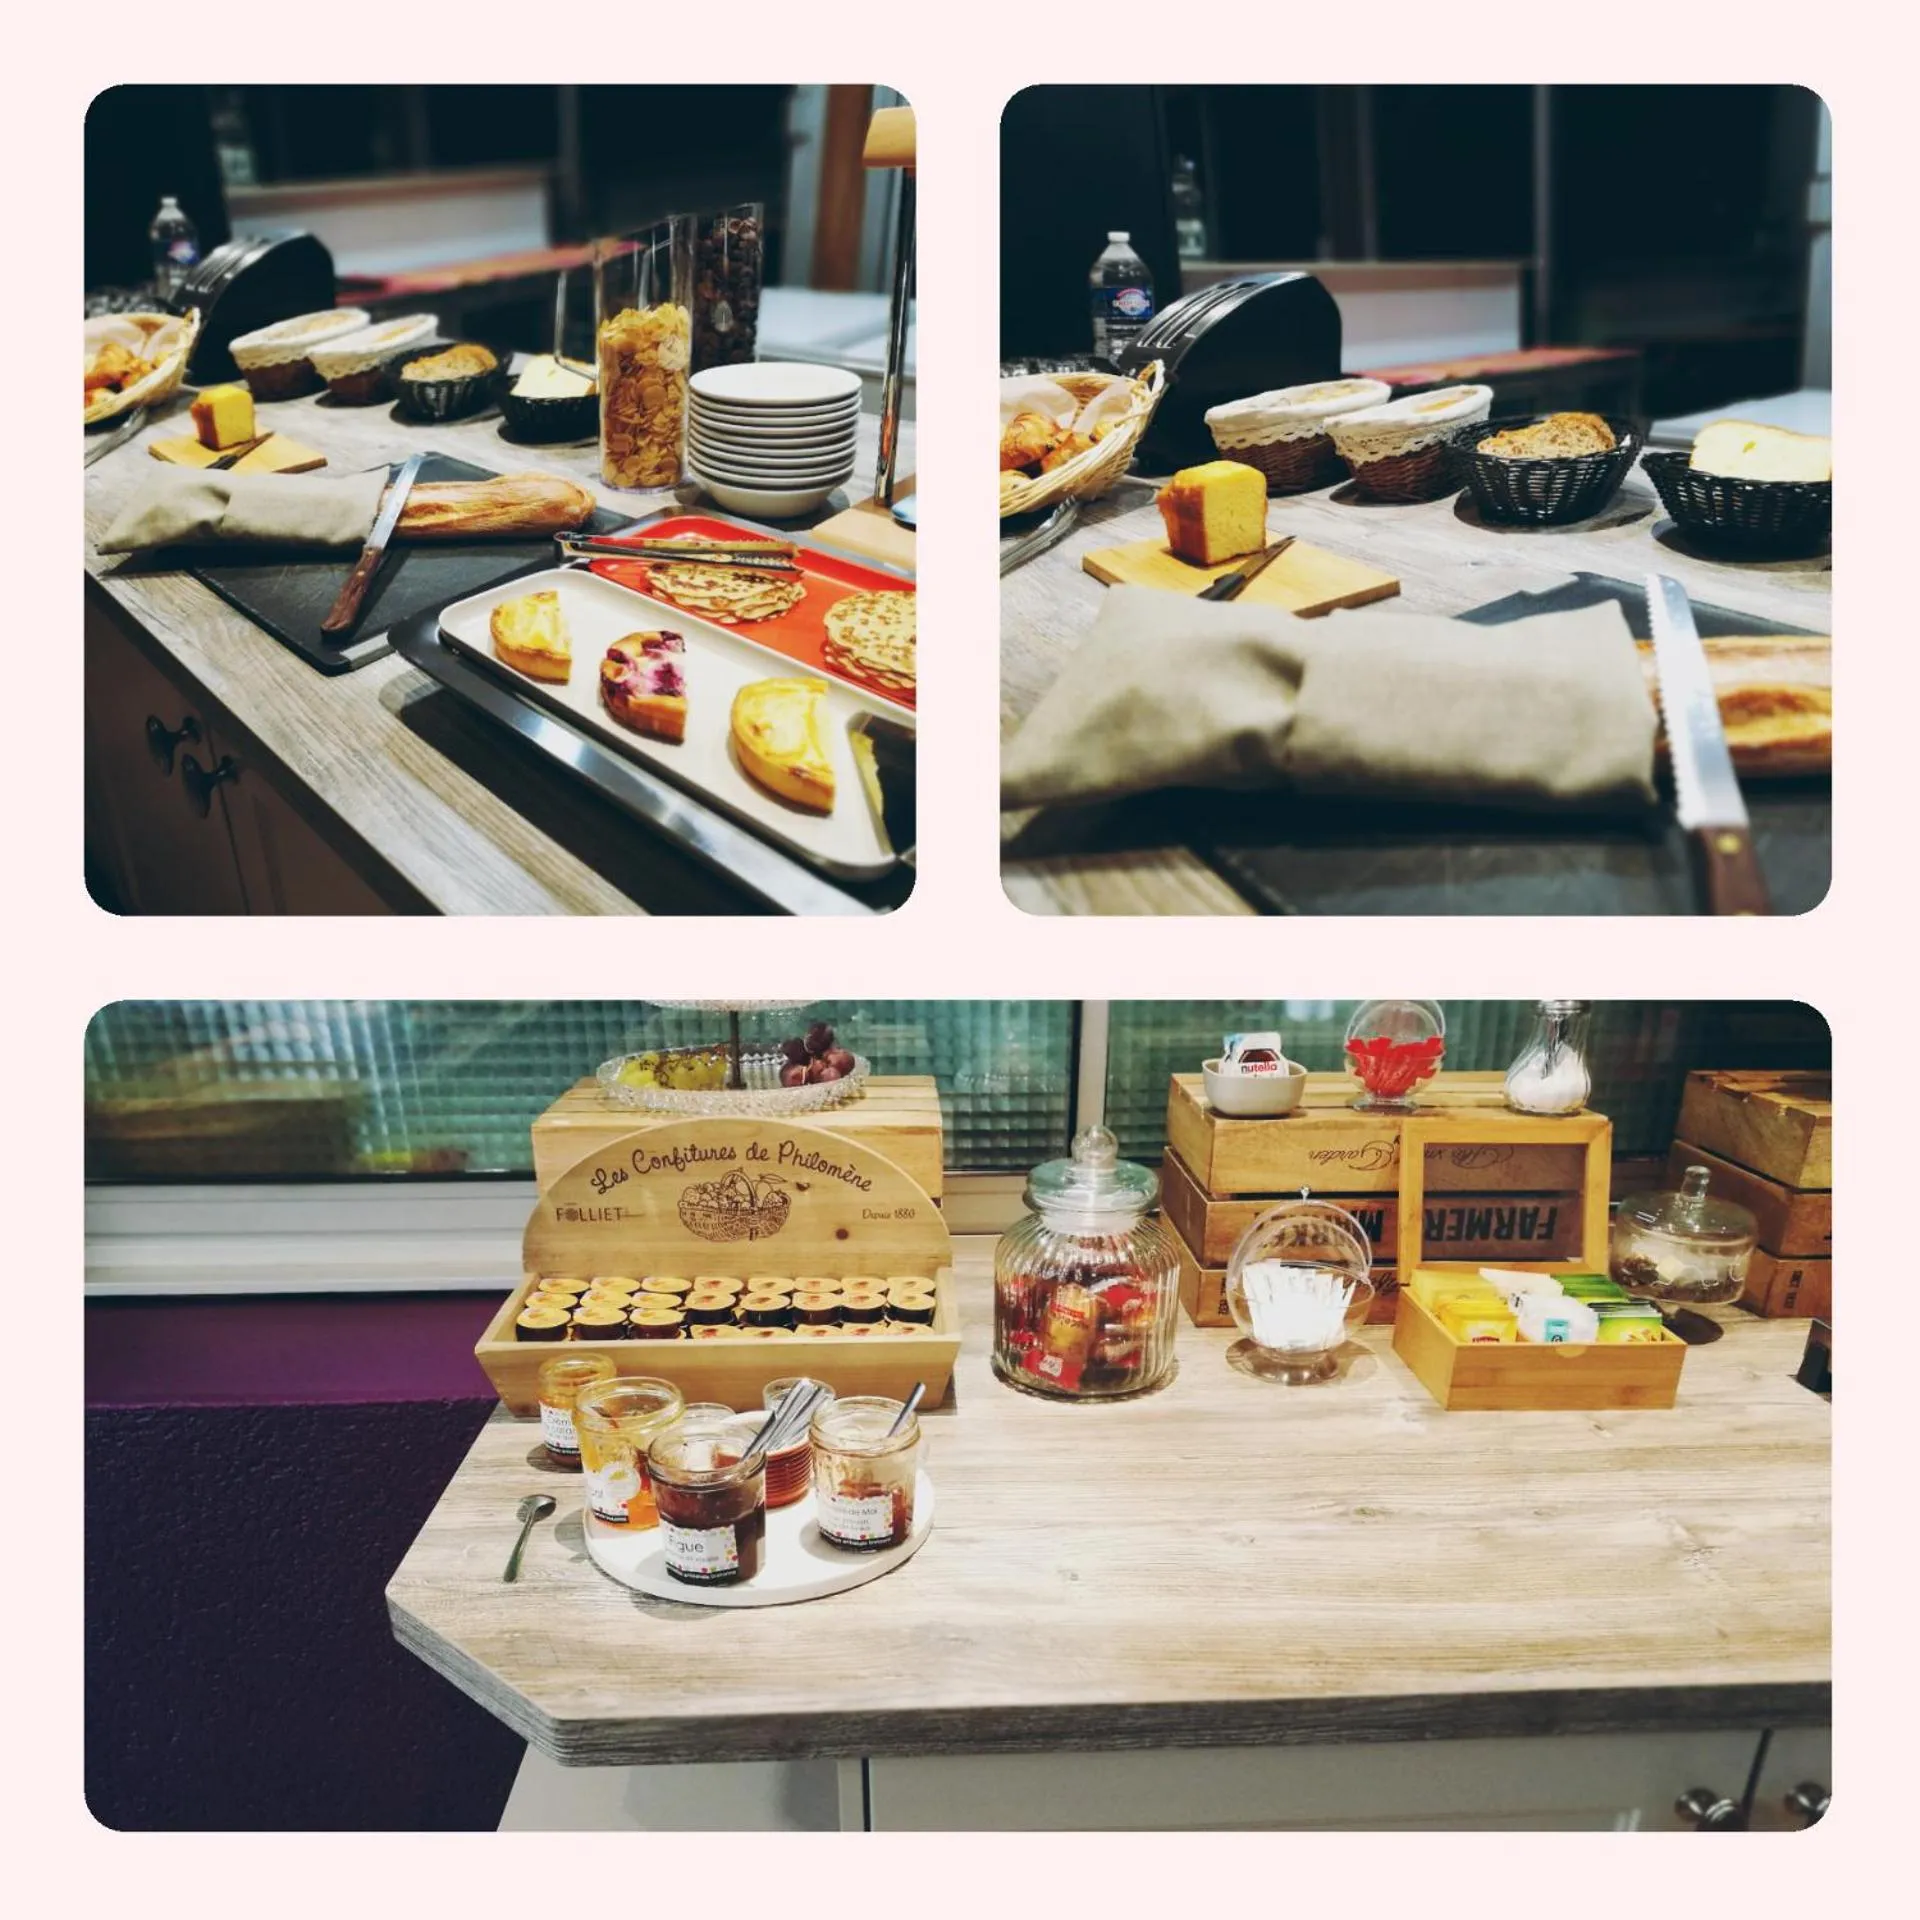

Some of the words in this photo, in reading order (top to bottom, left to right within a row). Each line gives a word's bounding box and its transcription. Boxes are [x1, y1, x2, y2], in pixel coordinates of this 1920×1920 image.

[1240, 1060, 1278, 1074] nutella
[591, 1167, 629, 1195] Les
[632, 1143, 737, 1175] Confitures
[745, 1142, 770, 1162] de
[778, 1139, 873, 1193] Philomène
[1308, 1139, 1396, 1172] Garden
[555, 1206, 624, 1222] FOLLIET
[1424, 1206, 1558, 1242] FARMER
